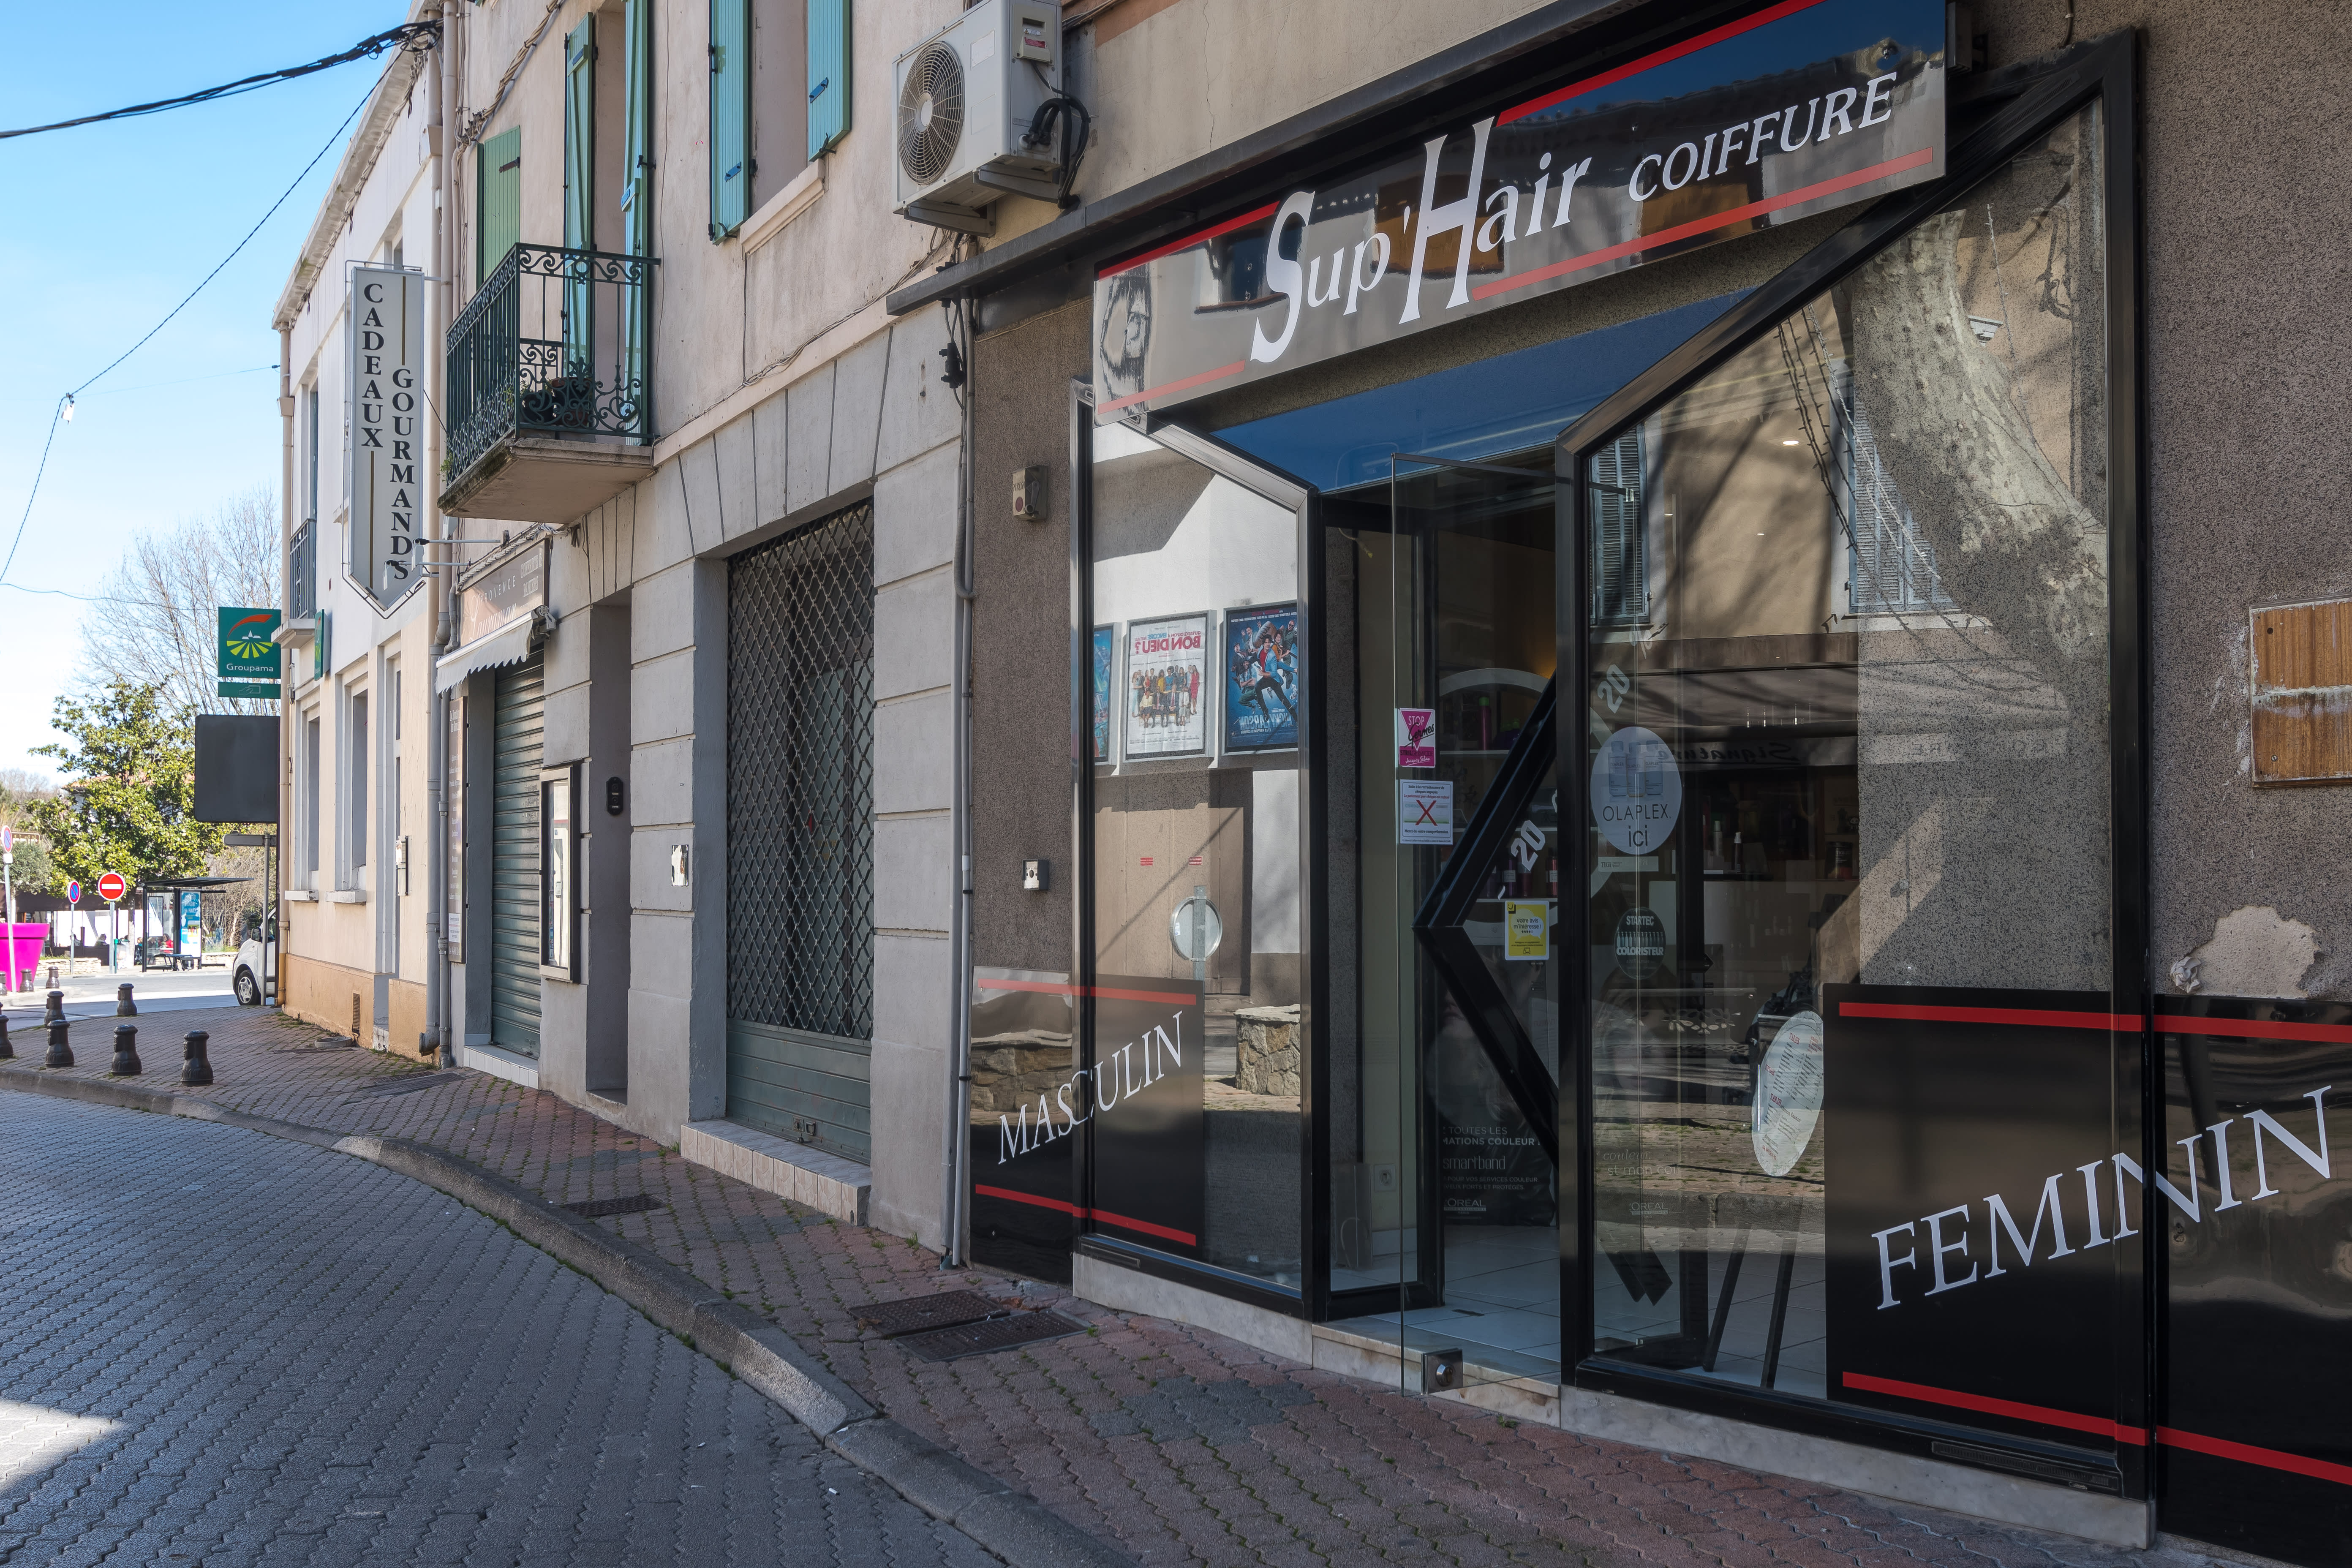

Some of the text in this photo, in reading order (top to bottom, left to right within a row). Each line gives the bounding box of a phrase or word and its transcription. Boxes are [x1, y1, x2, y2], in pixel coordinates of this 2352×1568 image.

[1629, 71, 1897, 202] COIFFURE
[361, 283, 384, 448] CADEAUX
[390, 368, 415, 580] GOURMANDS
[481, 575, 515, 603] PROVENCE
[226, 663, 274, 672] Groupama
[1408, 716, 1424, 726] STOP
[1408, 722, 1434, 749] Germes
[1628, 825, 1648, 847] ici
[1626, 915, 1654, 926] STARTEC
[998, 1010, 1182, 1165] MASCULIN
[1449, 1126, 1507, 1135] TOUTES LES
[1487, 1137, 1535, 1146] COULEUR
[1443, 1155, 1505, 1170] smartbond
[1624, 1166, 1652, 1175] mon
[1872, 1084, 2331, 1310] FEMININ
